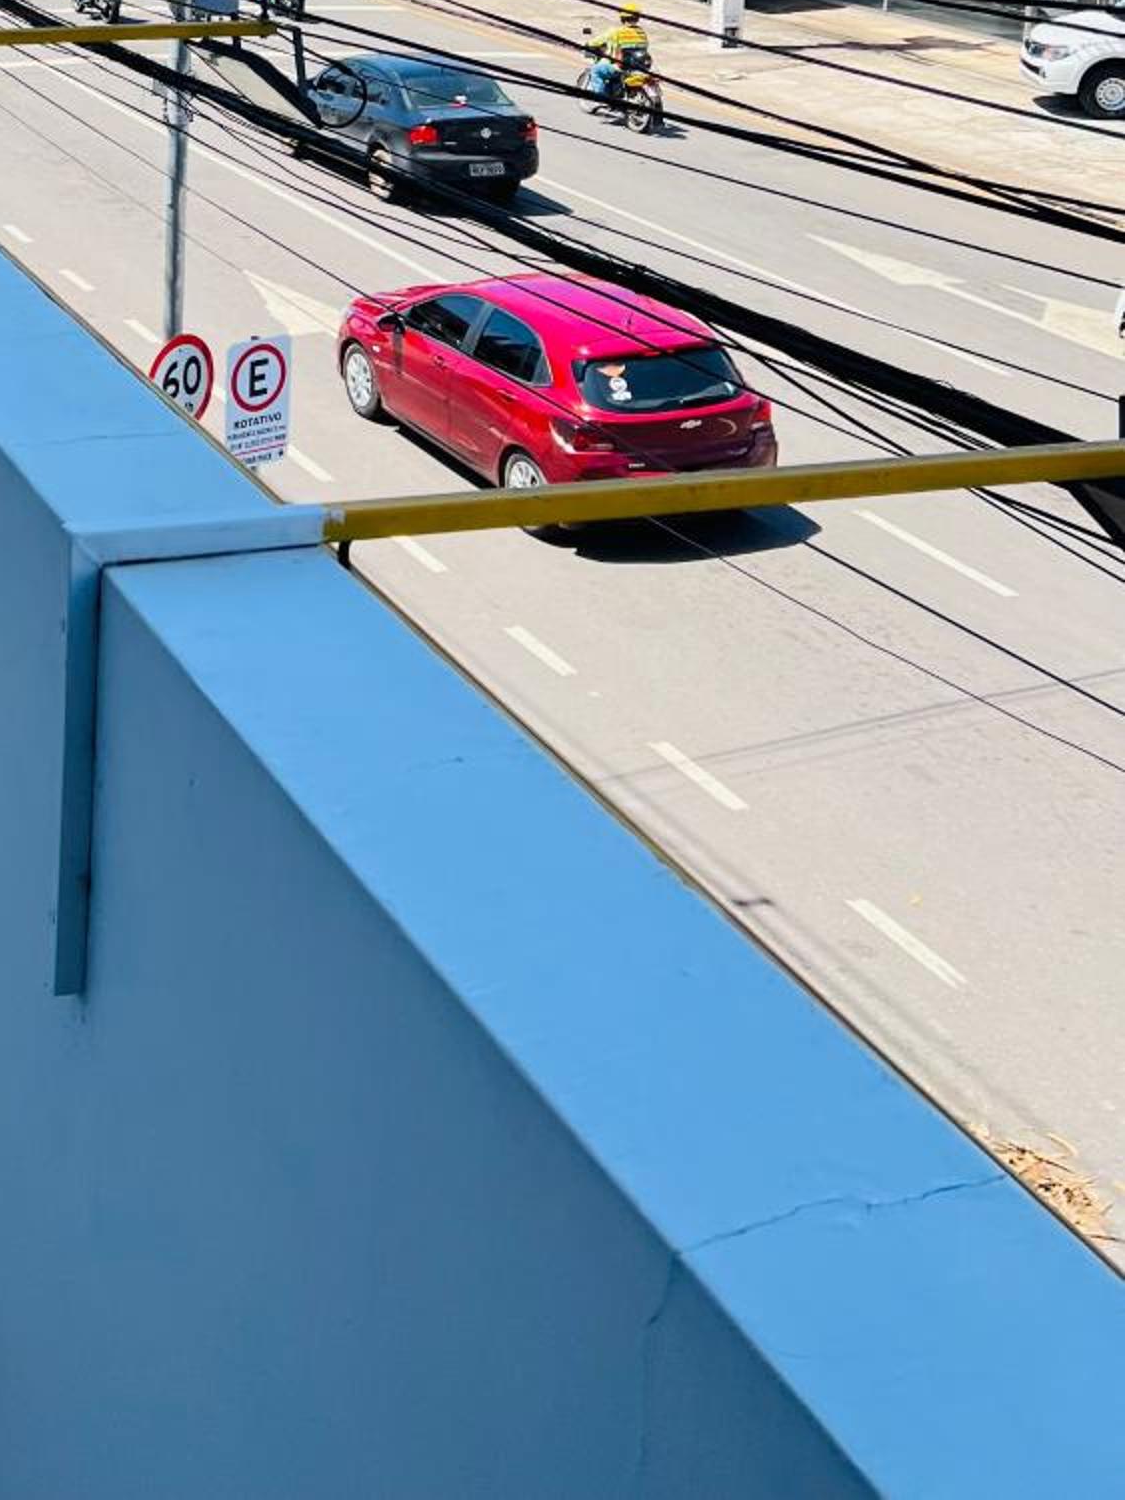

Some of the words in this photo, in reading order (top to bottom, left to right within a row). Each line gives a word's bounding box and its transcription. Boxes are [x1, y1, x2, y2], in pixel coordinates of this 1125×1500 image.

[162, 355, 201, 398] 60
[248, 358, 269, 397] E
[234, 411, 282, 429] ROTATIVO
